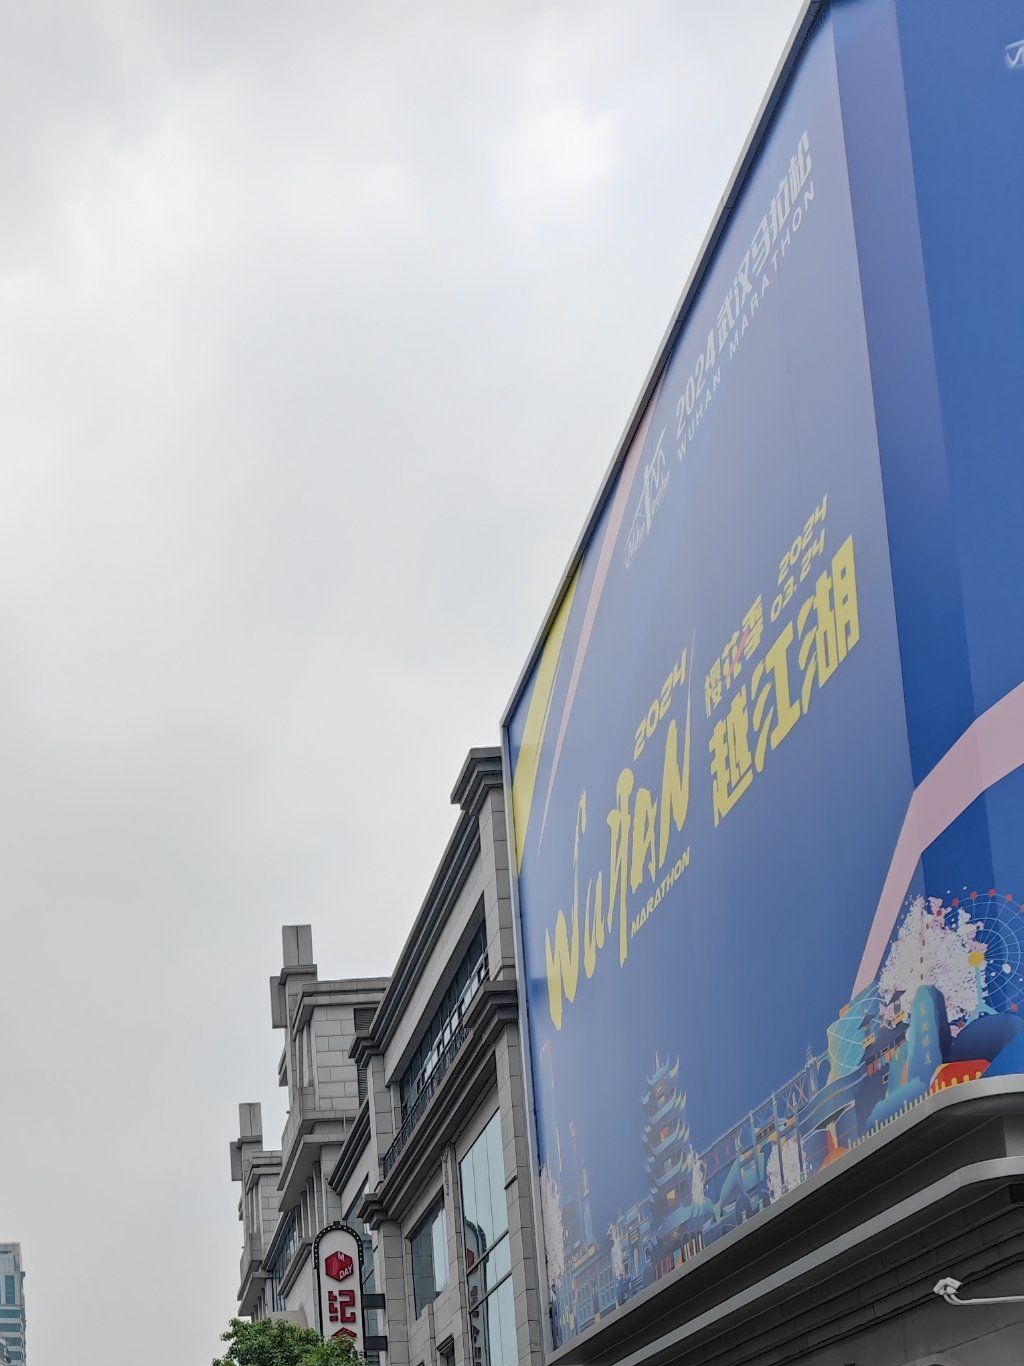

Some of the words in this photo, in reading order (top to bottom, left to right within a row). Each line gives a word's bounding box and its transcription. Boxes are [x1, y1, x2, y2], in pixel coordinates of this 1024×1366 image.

[678, 376, 721, 461] WUHAN
[729, 181, 815, 359] MARATHON
[778, 494, 827, 585] 2024
[633, 647, 688, 761] 2024
[709, 533, 860, 829] 越江湖
[631, 846, 690, 939] MARATHON
